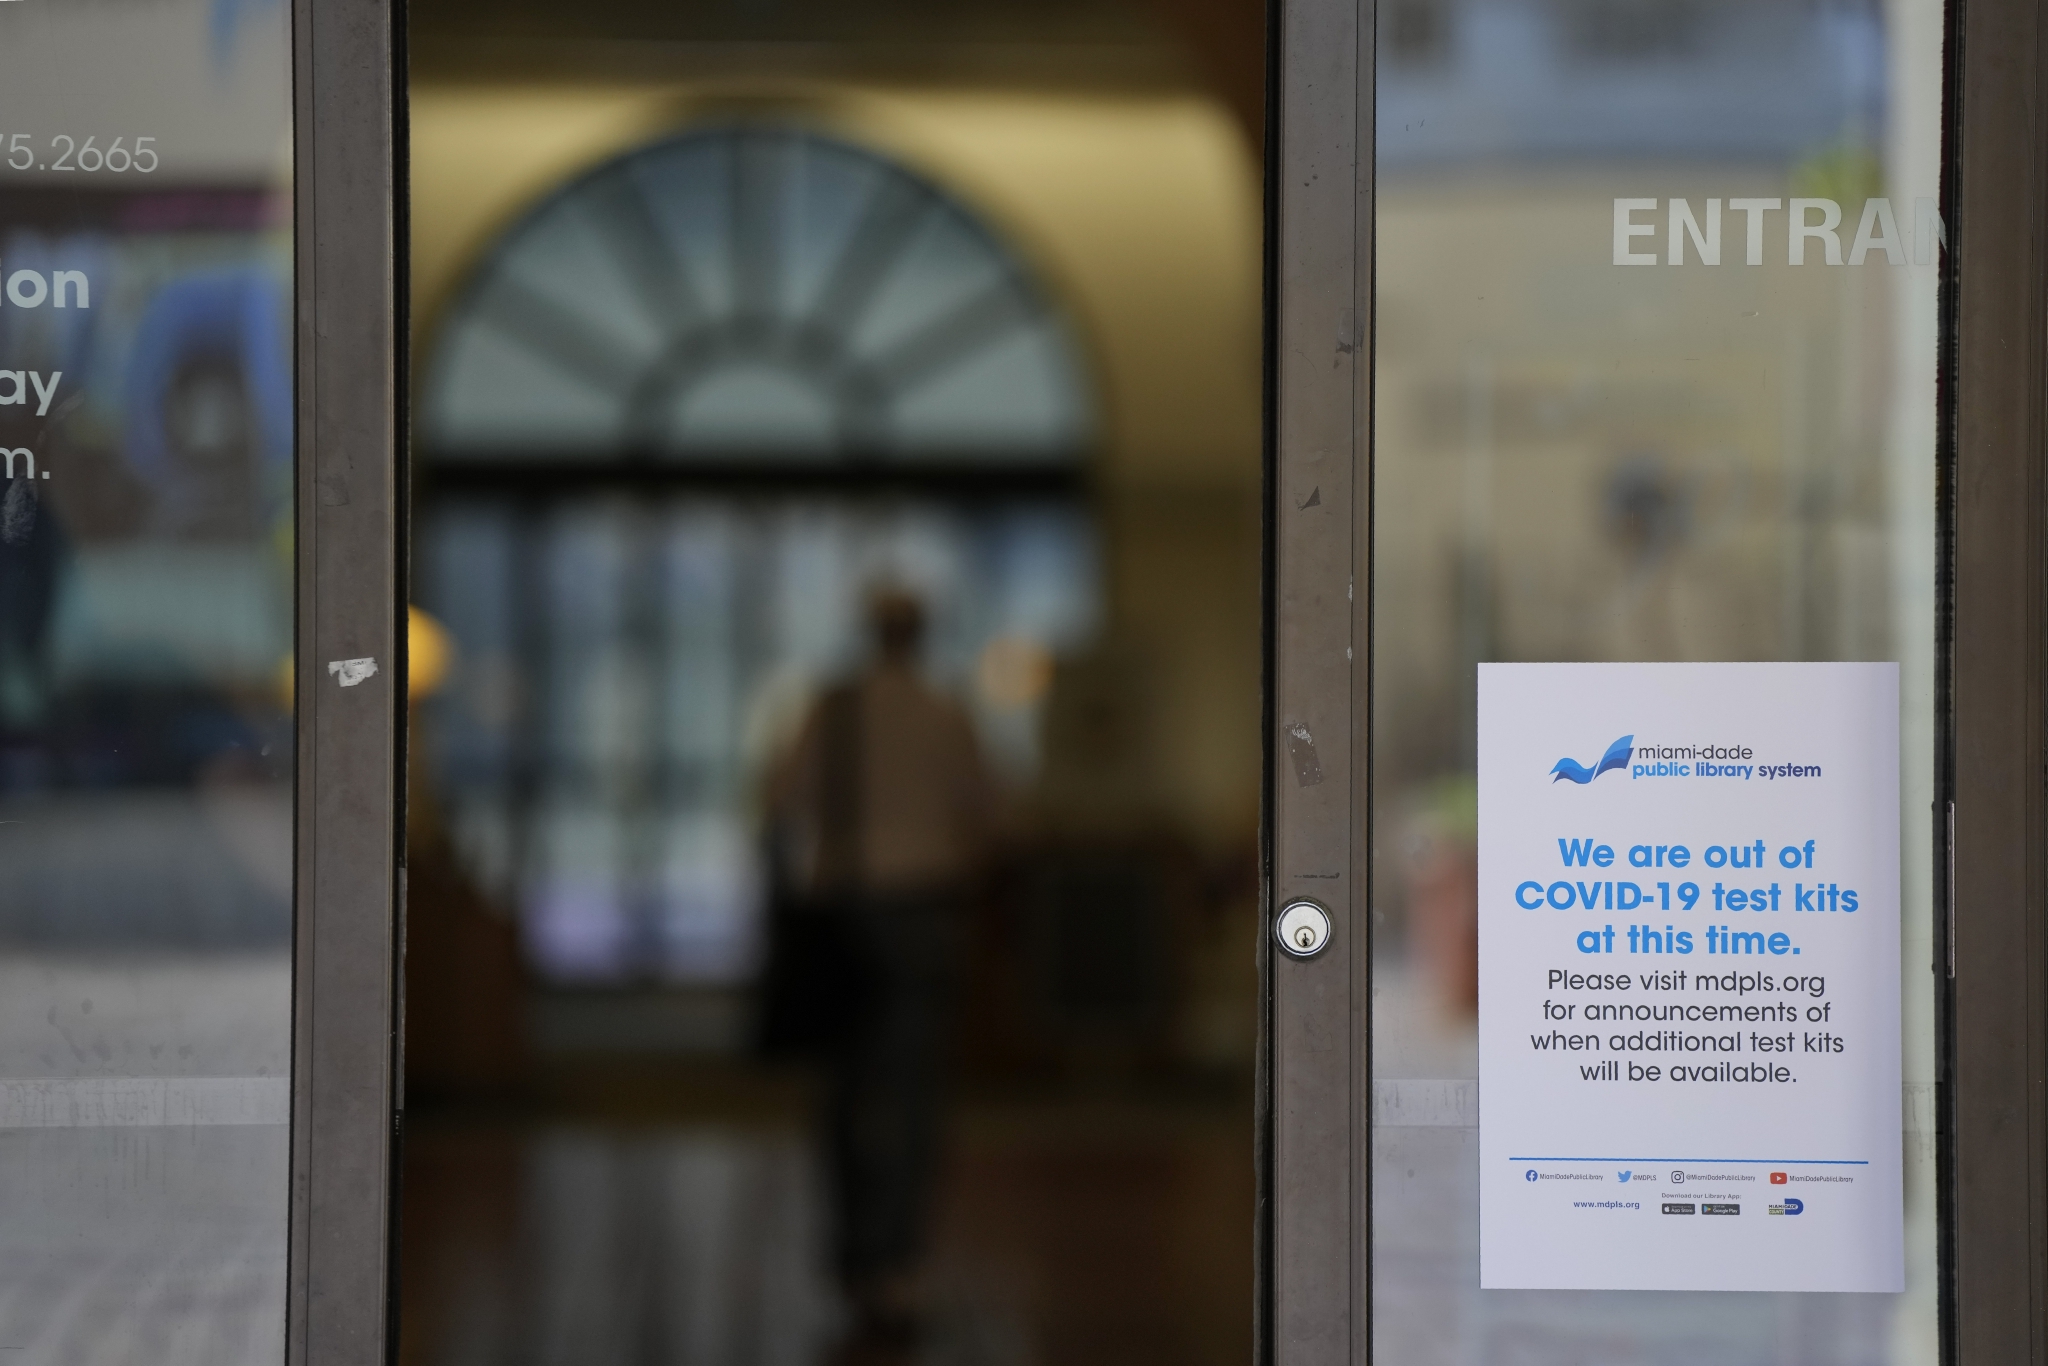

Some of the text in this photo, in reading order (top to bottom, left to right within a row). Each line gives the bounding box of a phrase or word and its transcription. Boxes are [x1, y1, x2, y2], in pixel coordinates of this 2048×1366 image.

[0, 133, 159, 173] 5.2665
[0, 369, 63, 417] ay
[1638, 744, 1754, 760] miami-dade
[1632, 761, 1822, 781] public library system
[1557, 837, 1816, 870] We are out of
[1514, 880, 1859, 913] COVID-19 test kits
[1576, 924, 1802, 956] at this time.
[1548, 969, 1826, 998] Please visit mdpls.org
[1542, 999, 1831, 1023] for announcements of
[1530, 1029, 1845, 1054] when additional test kits
[1579, 1060, 1798, 1083] will be available.
[1539, 1173, 1604, 1182] MiamiDadePublicLibrary
[1789, 1174, 1854, 1183] MiamiDadePublicLibrary
[1573, 1200, 1640, 1210] www.mdpls.org
